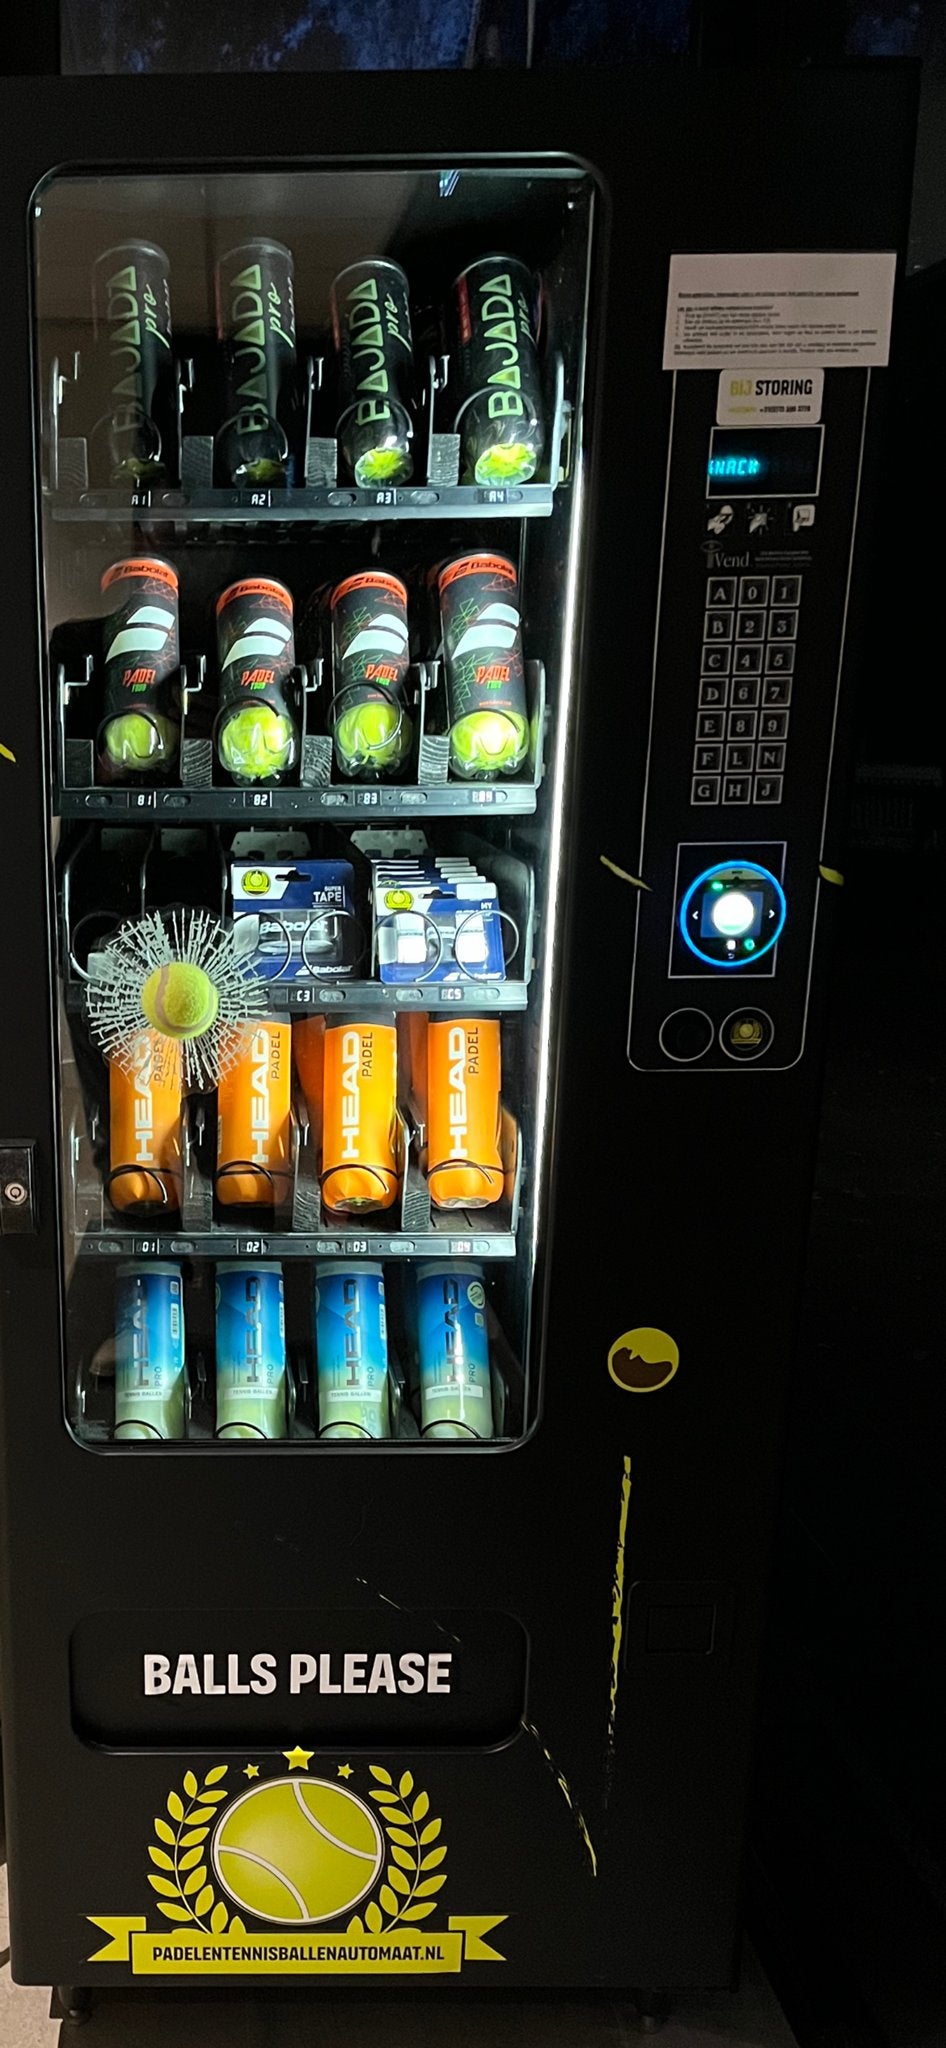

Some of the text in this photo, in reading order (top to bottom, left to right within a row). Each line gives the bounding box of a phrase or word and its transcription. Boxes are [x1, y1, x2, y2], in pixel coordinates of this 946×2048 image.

[144, 283, 170, 349] pro
[267, 282, 294, 349] pro
[384, 293, 413, 352] pro
[231, 264, 269, 435] BAJADA
[347, 278, 391, 426] BAJADA
[480, 274, 524, 419] BAJADA
[730, 379, 813, 396] BIJ STORING
[131, 494, 146, 505] A1
[251, 493, 266, 505] A2
[376, 491, 392, 504] A3
[489, 490, 504, 502] A4
[124, 565, 169, 579] Babolat
[714, 588, 727, 600] A
[748, 587, 757, 599] 0
[780, 587, 788, 599] 1
[712, 621, 724, 634] B
[745, 621, 754, 633] 2
[777, 621, 787, 633] 3
[708, 654, 721, 667] C
[740, 654, 750, 667] 4
[773, 654, 783, 666] 5
[122, 667, 157, 688] PADEL
[240, 669, 277, 686] PADEL
[364, 664, 398, 682] PADEL
[475, 665, 510, 684] PADEL
[706, 688, 719, 701] D
[739, 687, 748, 700] 6
[771, 687, 780, 700] 7
[703, 720, 716, 733] E
[736, 719, 745, 732] 8
[767, 719, 777, 732] 9
[702, 752, 713, 765] F
[732, 752, 742, 765] L
[763, 752, 776, 764] N
[698, 785, 710, 797] G
[728, 785, 742, 797] H
[762, 784, 771, 796] J
[313, 891, 342, 902] TAPE
[296, 990, 311, 1002] C3
[271, 1031, 281, 1079] PADEL
[362, 1032, 373, 1077] PADEL
[467, 1027, 479, 1074] PADEL
[134, 1035, 154, 1162] HEAD
[252, 1028, 269, 1164] HEAD
[341, 1031, 360, 1159] HEAD
[449, 1027, 468, 1159] HEAD
[245, 1276, 263, 1382] HEAD
[343, 1279, 361, 1386] HEAD
[443, 1279, 464, 1384] HEAD
[155, 1366, 163, 1387] PRO
[468, 1363, 476, 1383] PRO
[143, 1653, 452, 1695] BALLS PLEASE
[152, 1946, 445, 1961] PADELENTENNISBALLENAUTOMAAT.NL
